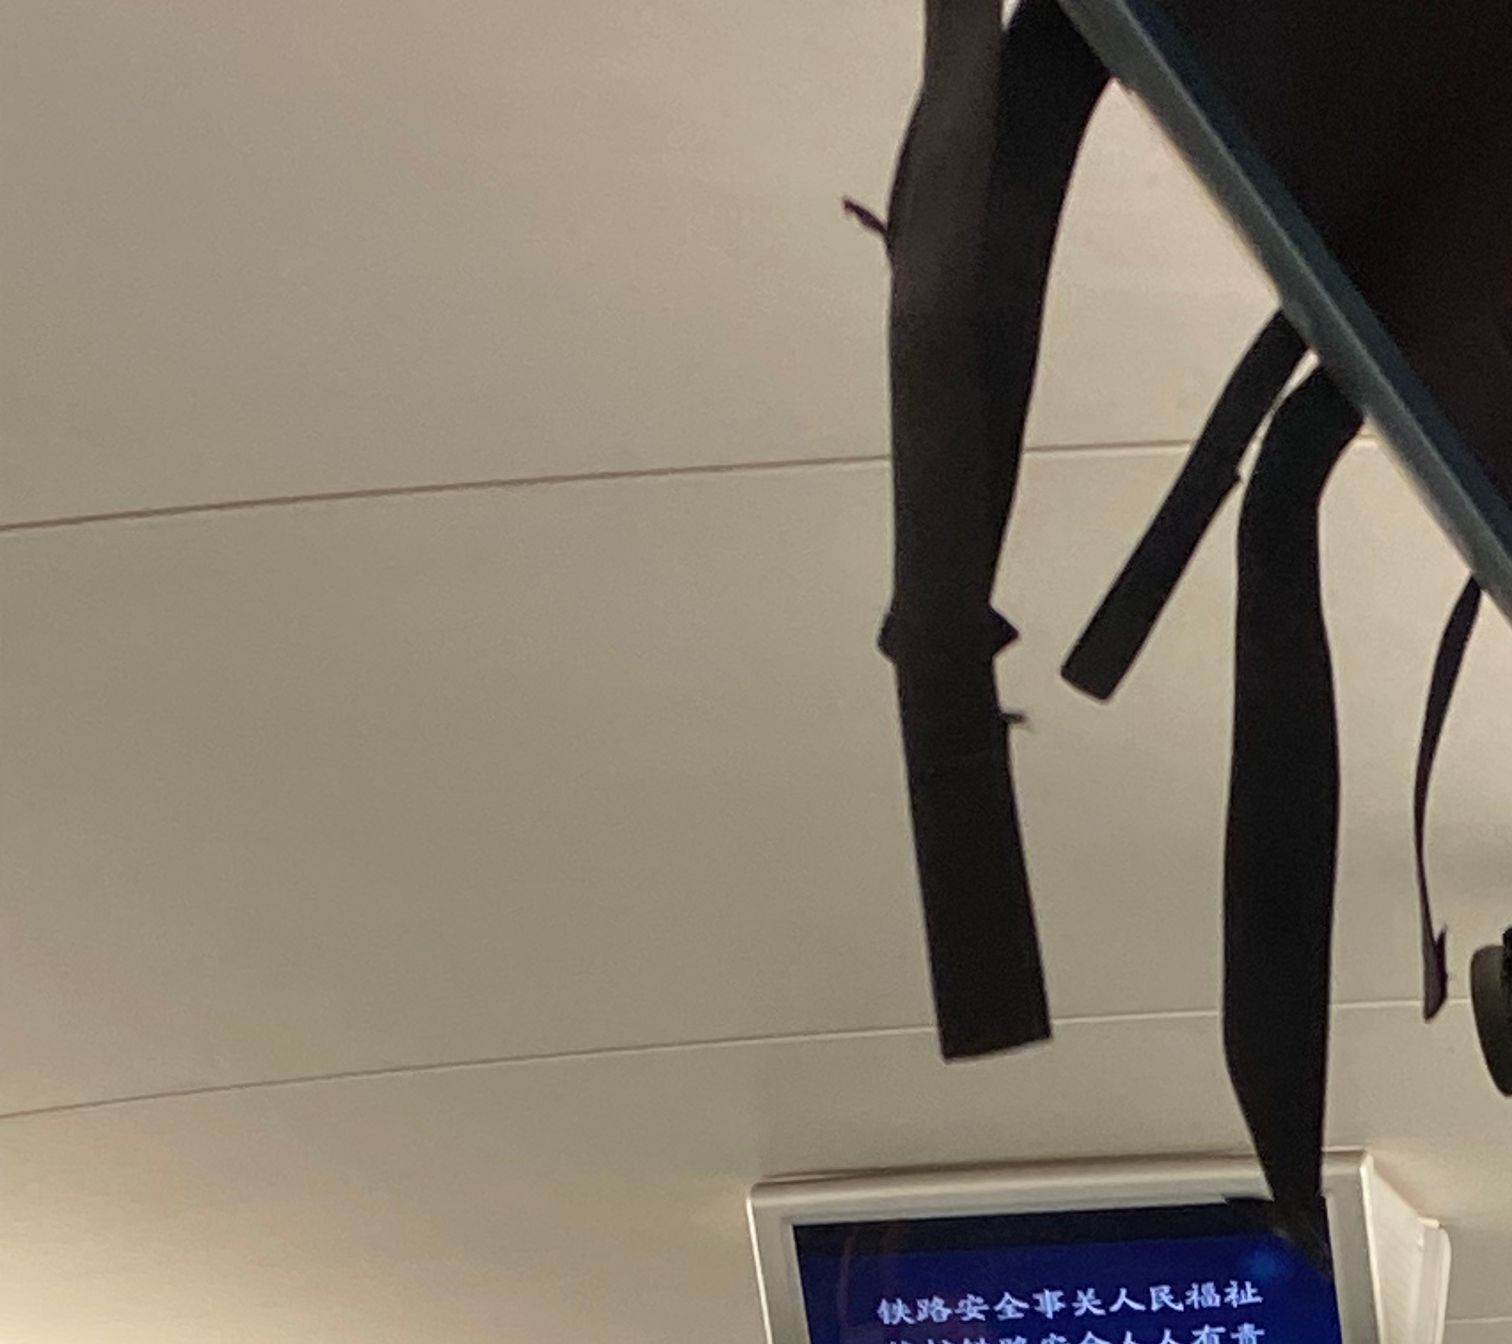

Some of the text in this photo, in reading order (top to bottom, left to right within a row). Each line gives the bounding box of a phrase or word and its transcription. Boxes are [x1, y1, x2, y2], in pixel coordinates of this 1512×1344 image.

[877, 1280, 1264, 1327] 铁路安全事关人民福祉
